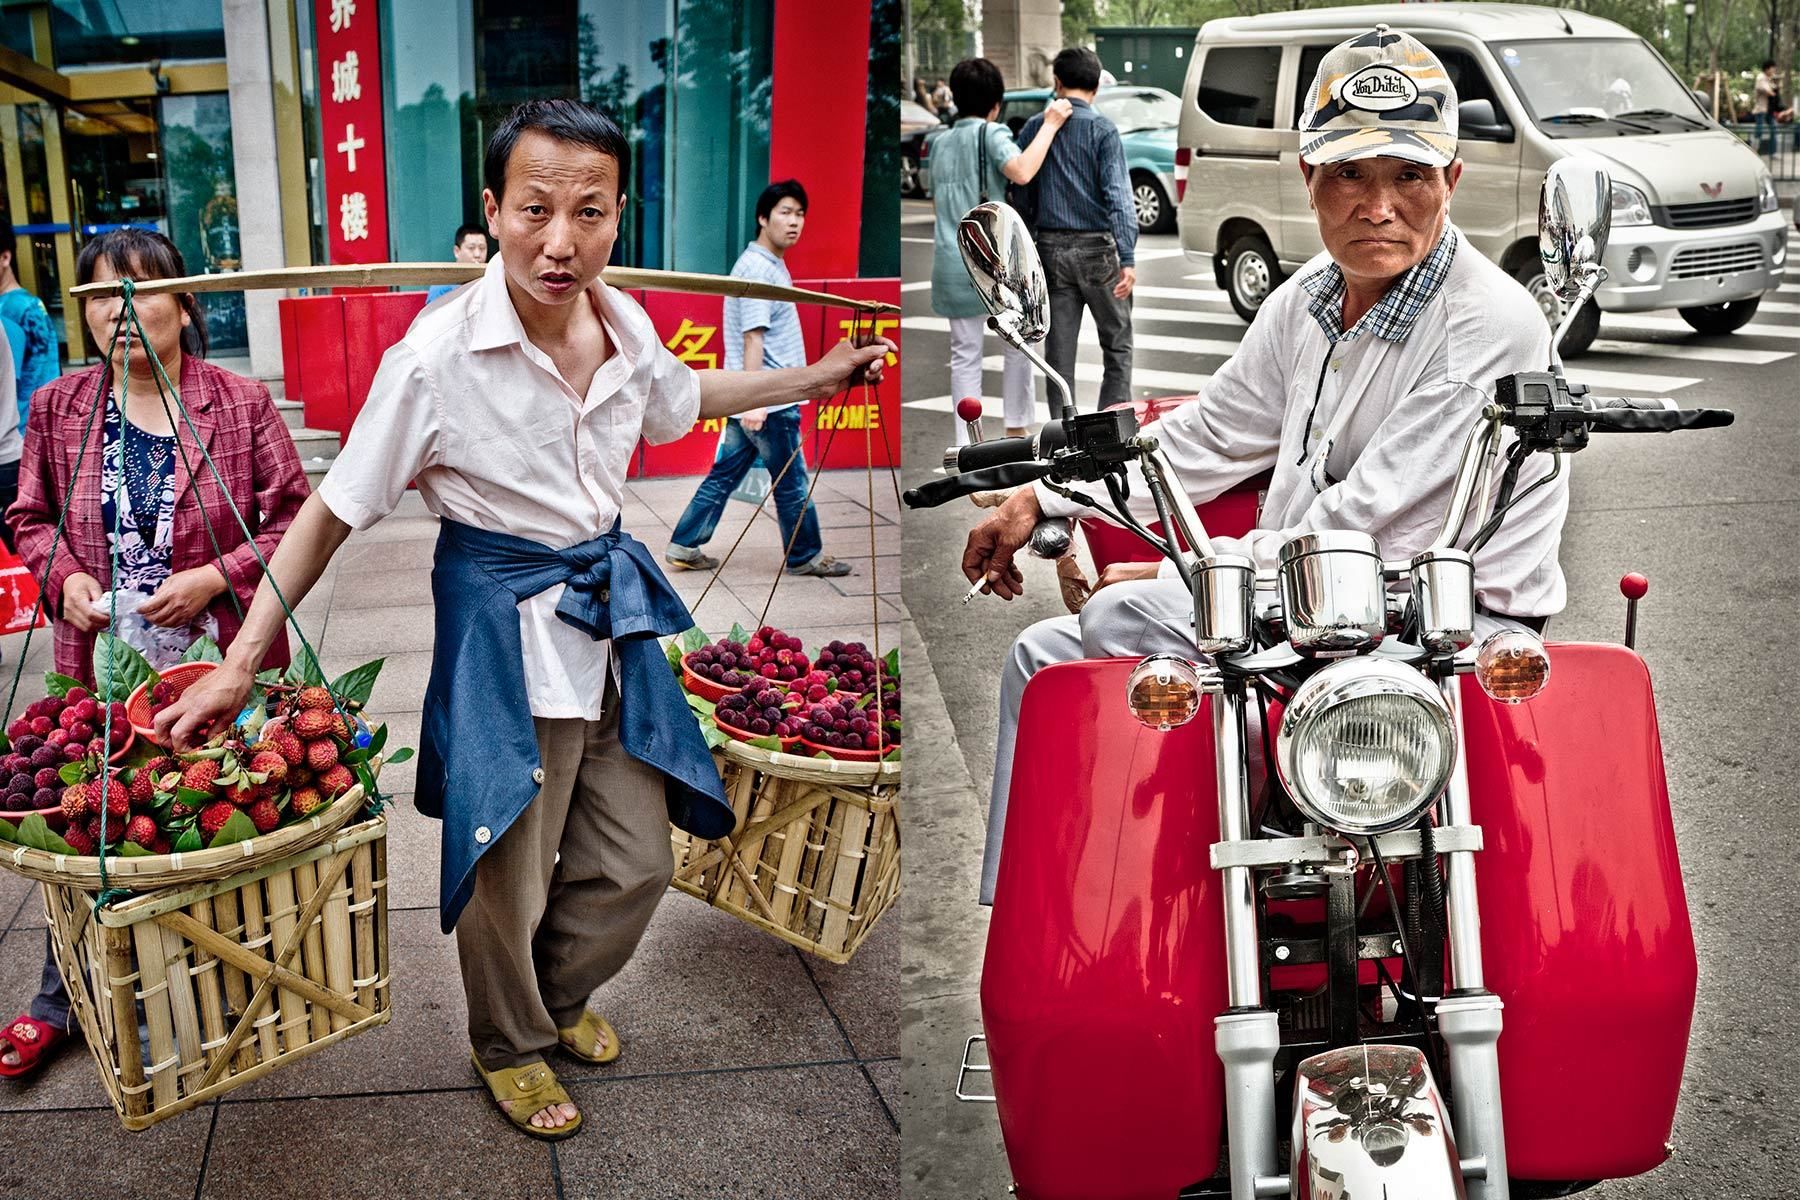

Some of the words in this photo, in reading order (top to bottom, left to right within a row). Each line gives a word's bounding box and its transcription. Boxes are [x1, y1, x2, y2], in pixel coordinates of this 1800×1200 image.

[1352, 79, 1372, 95] Von
[1372, 75, 1407, 97] Dutch
[816, 404, 880, 430] HOME
